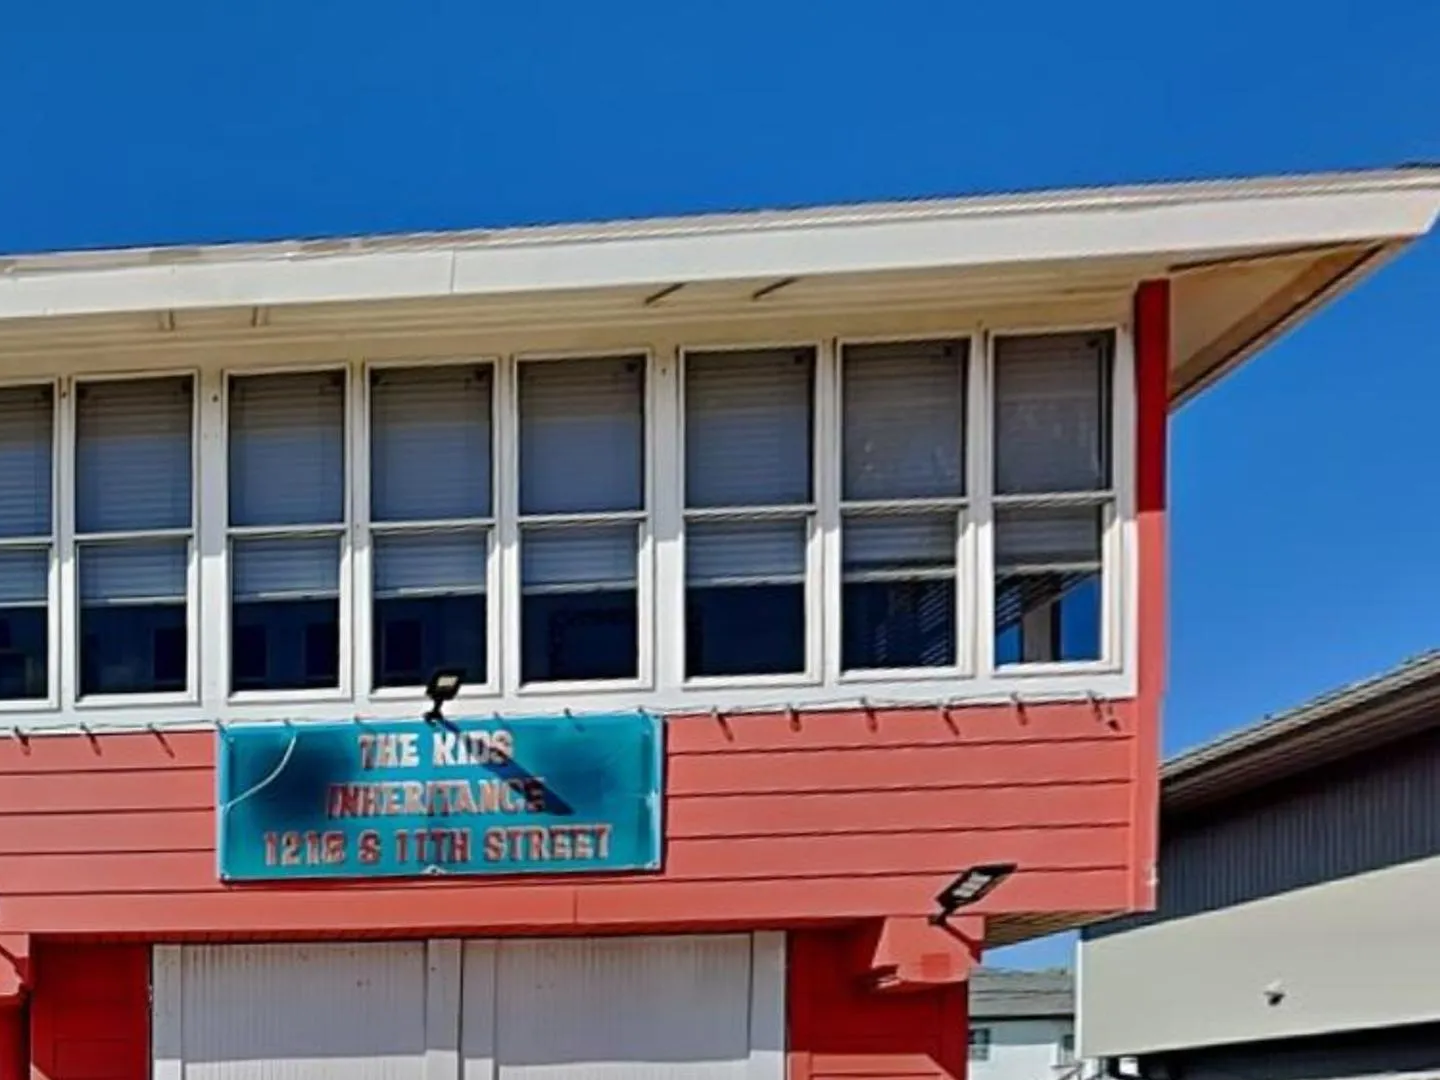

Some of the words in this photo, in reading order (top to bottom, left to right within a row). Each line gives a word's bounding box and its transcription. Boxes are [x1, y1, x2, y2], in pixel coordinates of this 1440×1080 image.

[358, 732, 419, 769] THE
[432, 730, 514, 766] KIDS
[327, 777, 545, 818] INHERITANCE
[395, 828, 470, 863] 11TH
[484, 824, 613, 861] STREET
